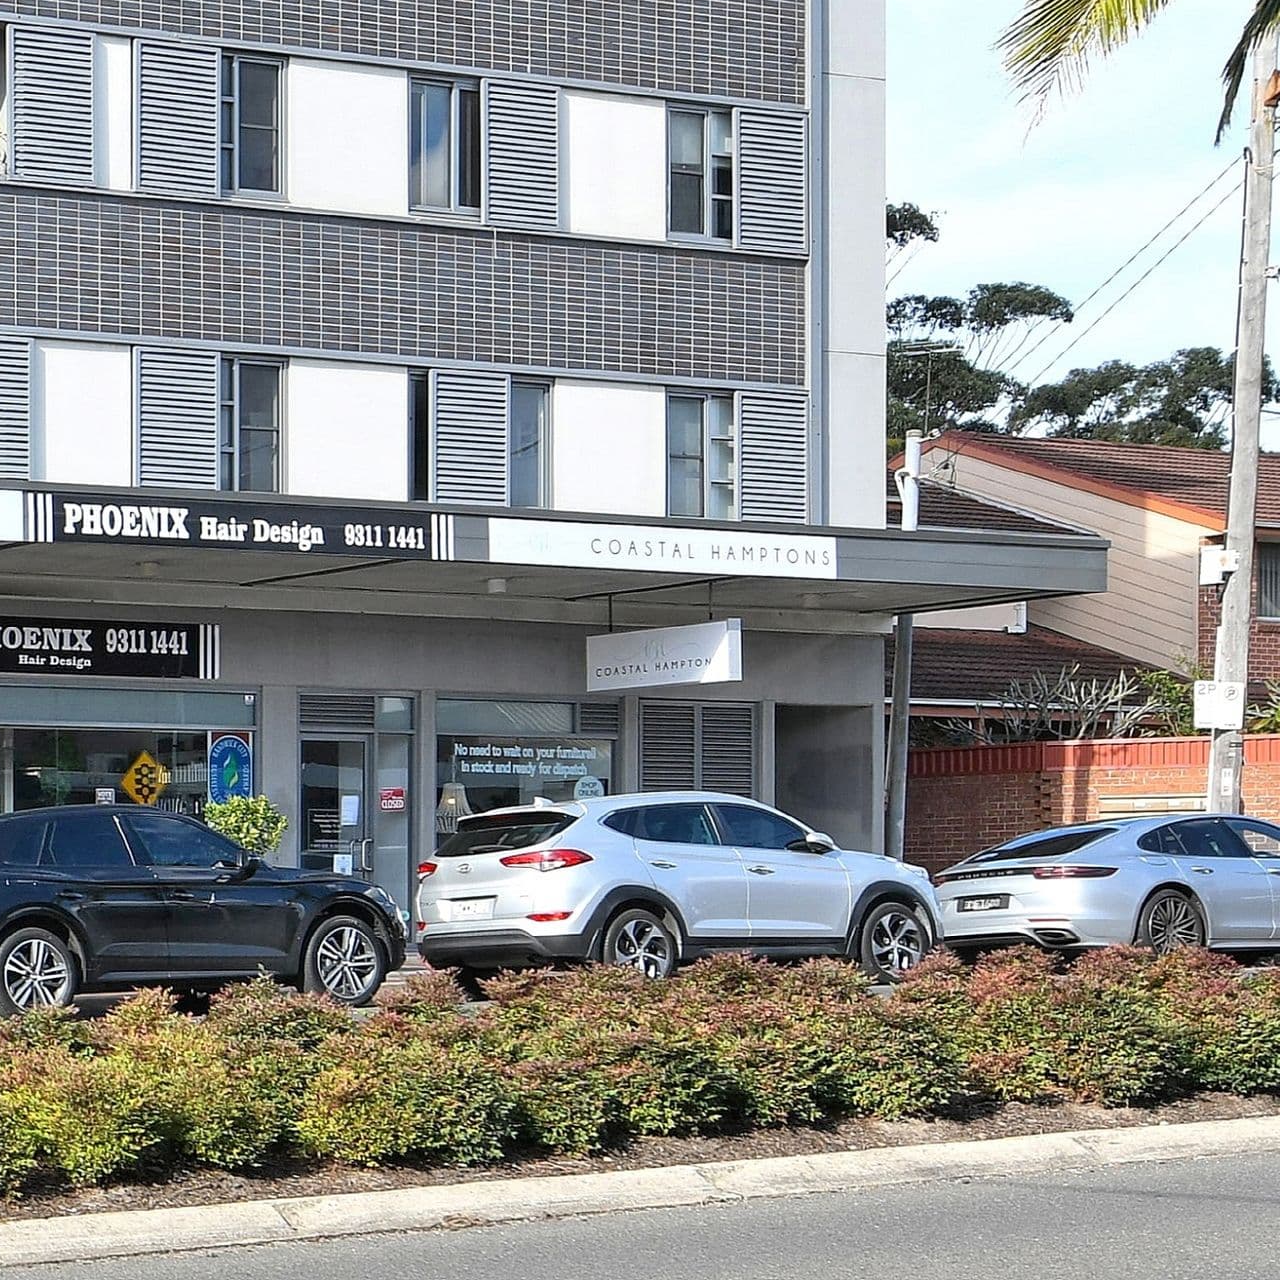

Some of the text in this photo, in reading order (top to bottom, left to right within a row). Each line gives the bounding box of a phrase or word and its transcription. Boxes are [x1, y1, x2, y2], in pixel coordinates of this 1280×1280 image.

[63, 503, 425, 551] PHOENIX Hair Design 9311 1441
[591, 538, 830, 566] COASTAL HAMPTONS
[105, 628, 147, 654] 9311
[150, 630, 189, 655] 1441
[18, 654, 92, 669] Hair Design
[595, 664, 648, 678] COASTAL
[1198, 683, 1216, 695] 2P
[455, 743, 468, 756] No
[469, 743, 491, 757] need
[492, 746, 502, 757] to
[503, 745, 521, 757] wait
[523, 748, 533, 758] on
[536, 748, 555, 760] your
[461, 760, 587, 778] In stock and ready for dispatch
[381, 799, 404, 809] CLOSED
